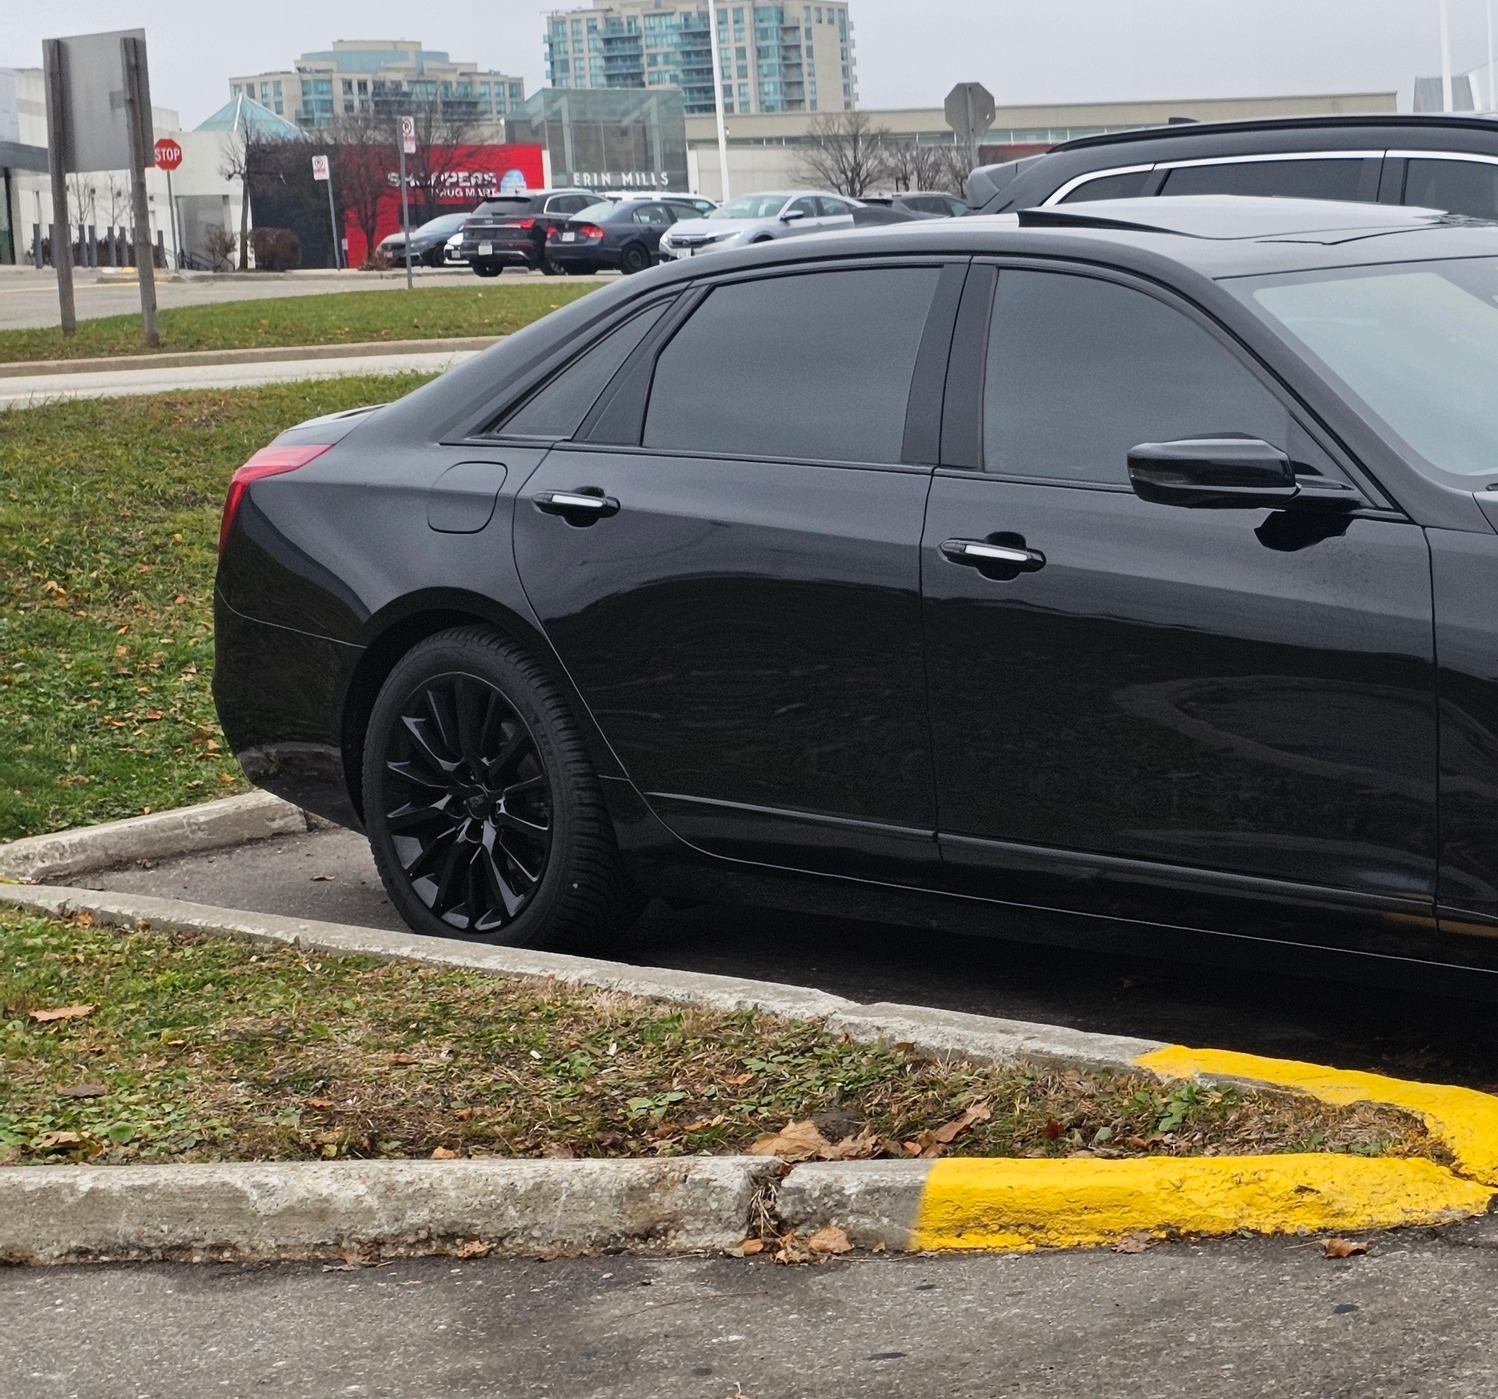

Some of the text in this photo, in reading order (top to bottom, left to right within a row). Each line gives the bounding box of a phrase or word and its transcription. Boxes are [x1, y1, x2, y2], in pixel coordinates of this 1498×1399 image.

[154, 147, 180, 161] STOP
[387, 171, 498, 188] SHPPERS
[573, 172, 669, 186] ERIN MILLS
